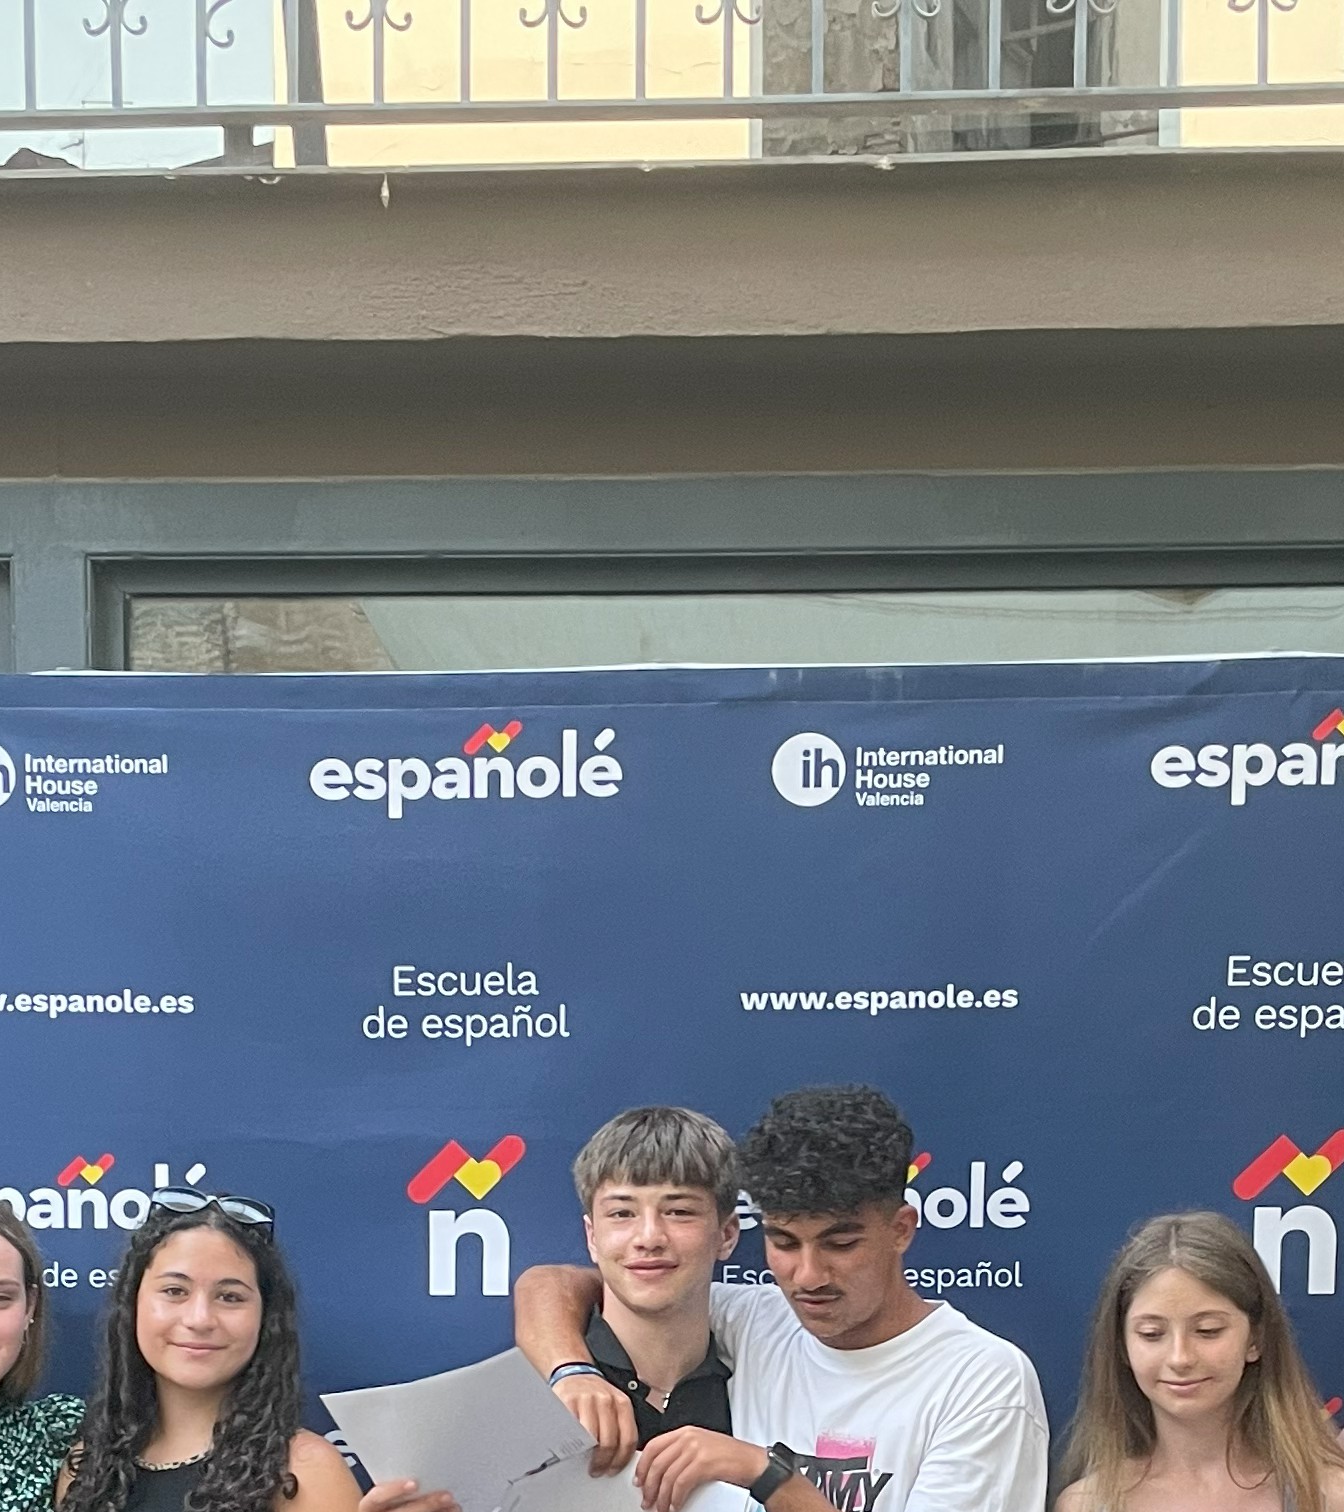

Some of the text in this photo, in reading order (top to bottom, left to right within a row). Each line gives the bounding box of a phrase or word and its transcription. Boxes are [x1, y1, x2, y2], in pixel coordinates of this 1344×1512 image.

[24, 752, 168, 775] International
[856, 743, 1005, 768] International
[25, 774, 98, 797] House
[855, 768, 931, 790] House
[26, 797, 93, 813] Valencia
[855, 790, 924, 808] Valencia
[393, 961, 540, 998] Escuela
[740, 983, 1019, 1017] www.espanole.es
[362, 1003, 570, 1047] de español
[1192, 995, 1241, 1031] de
